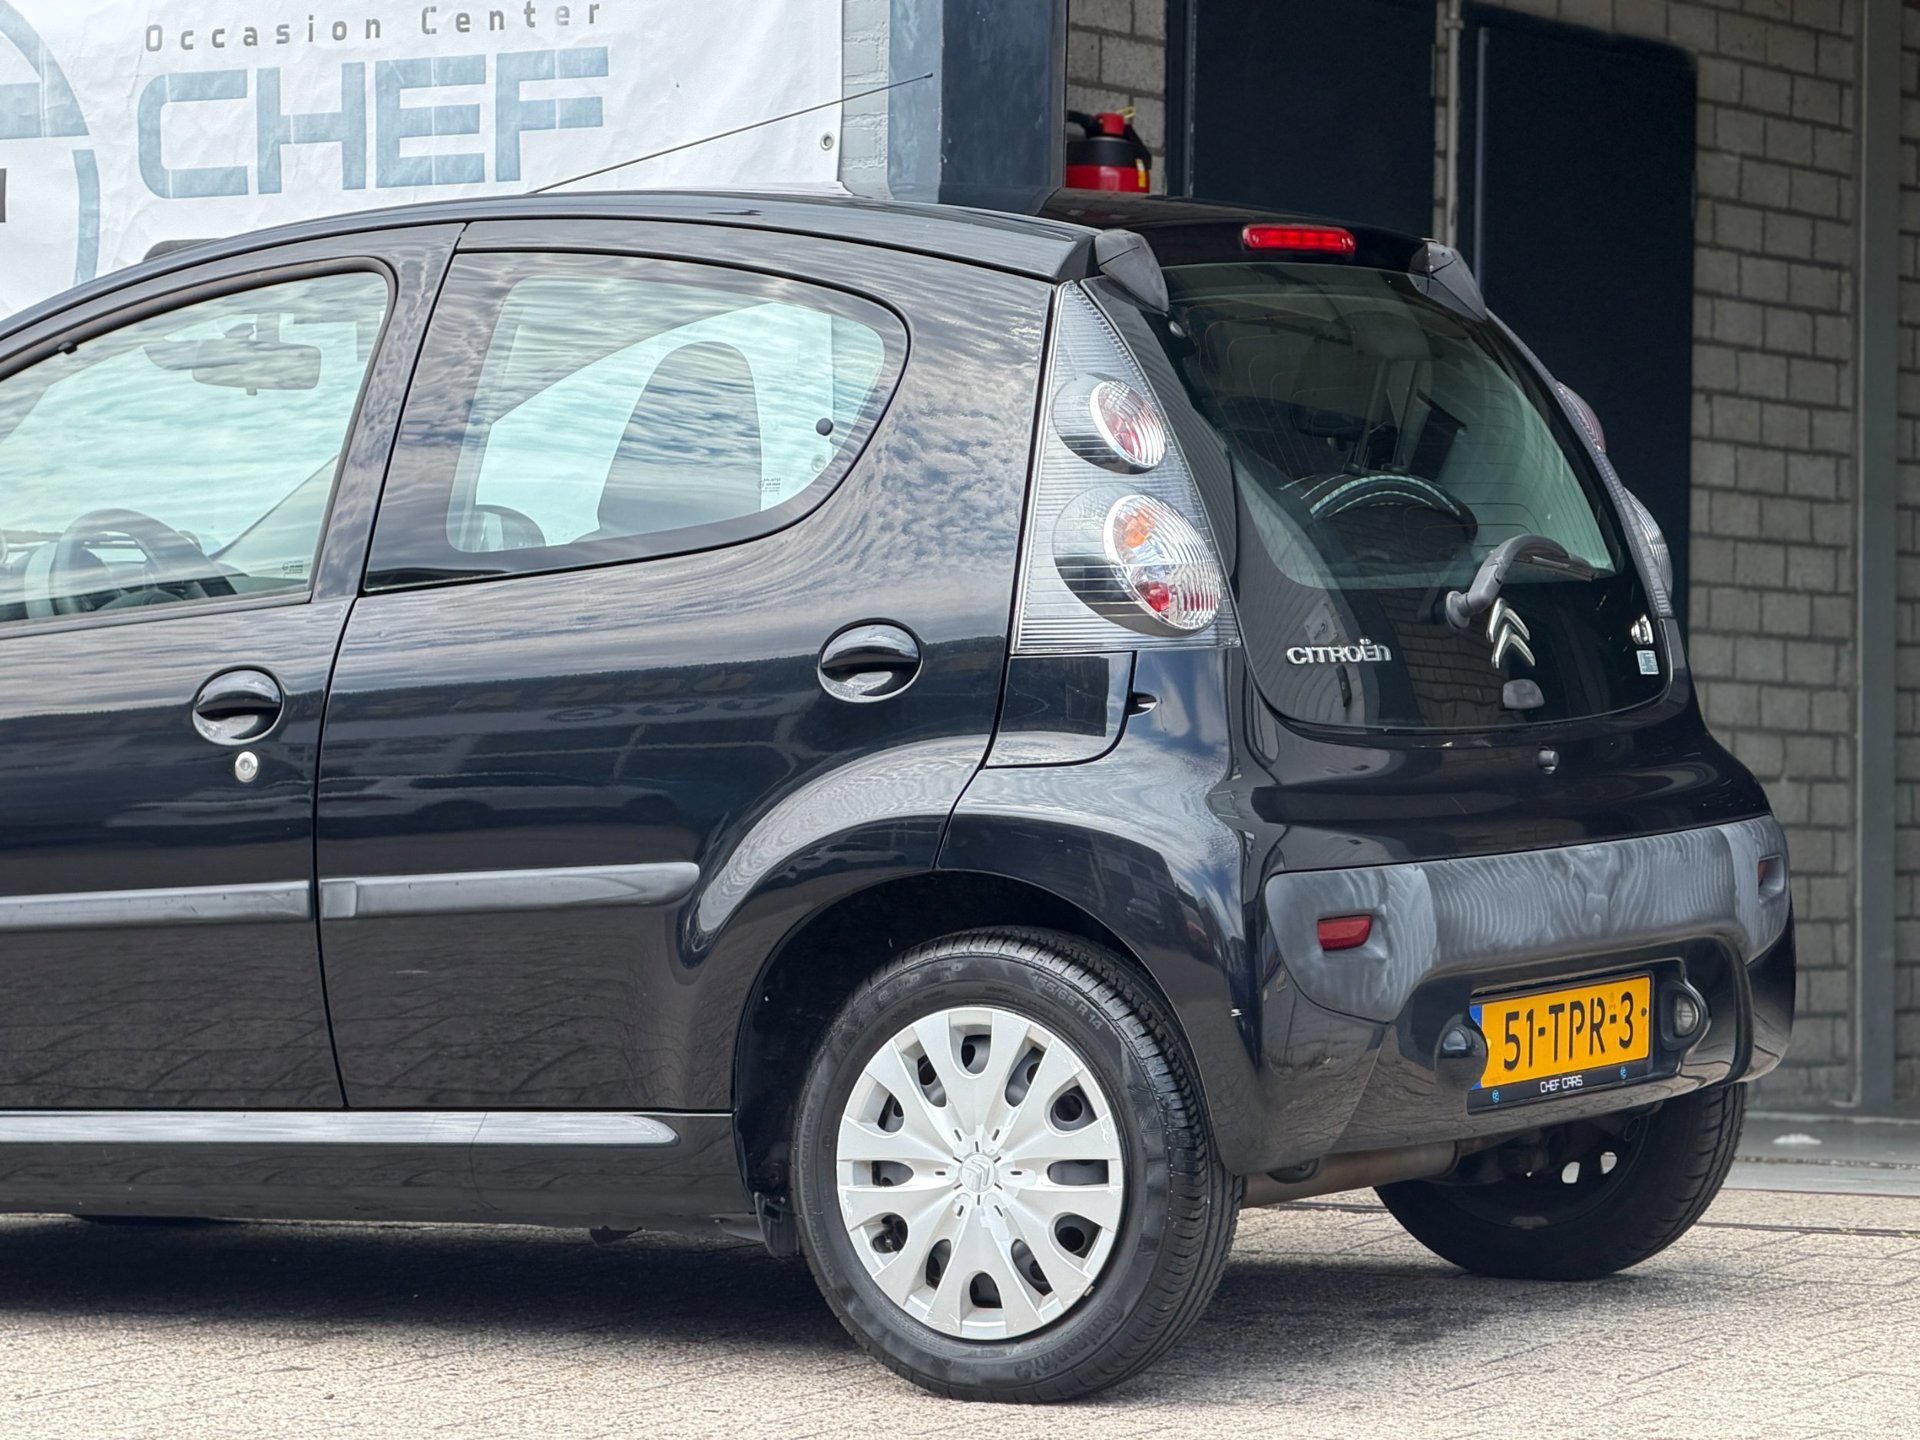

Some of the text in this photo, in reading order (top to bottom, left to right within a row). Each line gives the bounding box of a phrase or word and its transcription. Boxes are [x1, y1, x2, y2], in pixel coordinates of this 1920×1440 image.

[145, 1, 600, 52] Occasion Center
[137, 46, 610, 200] CHEF
[1030, 974, 1077, 1007] 155/65
[1075, 1002, 1089, 1017] R
[1088, 1013, 1104, 1031] 14
[1503, 991, 1634, 1071] 51-TPR-3
[1540, 1074, 1583, 1093] CHEF CARS
